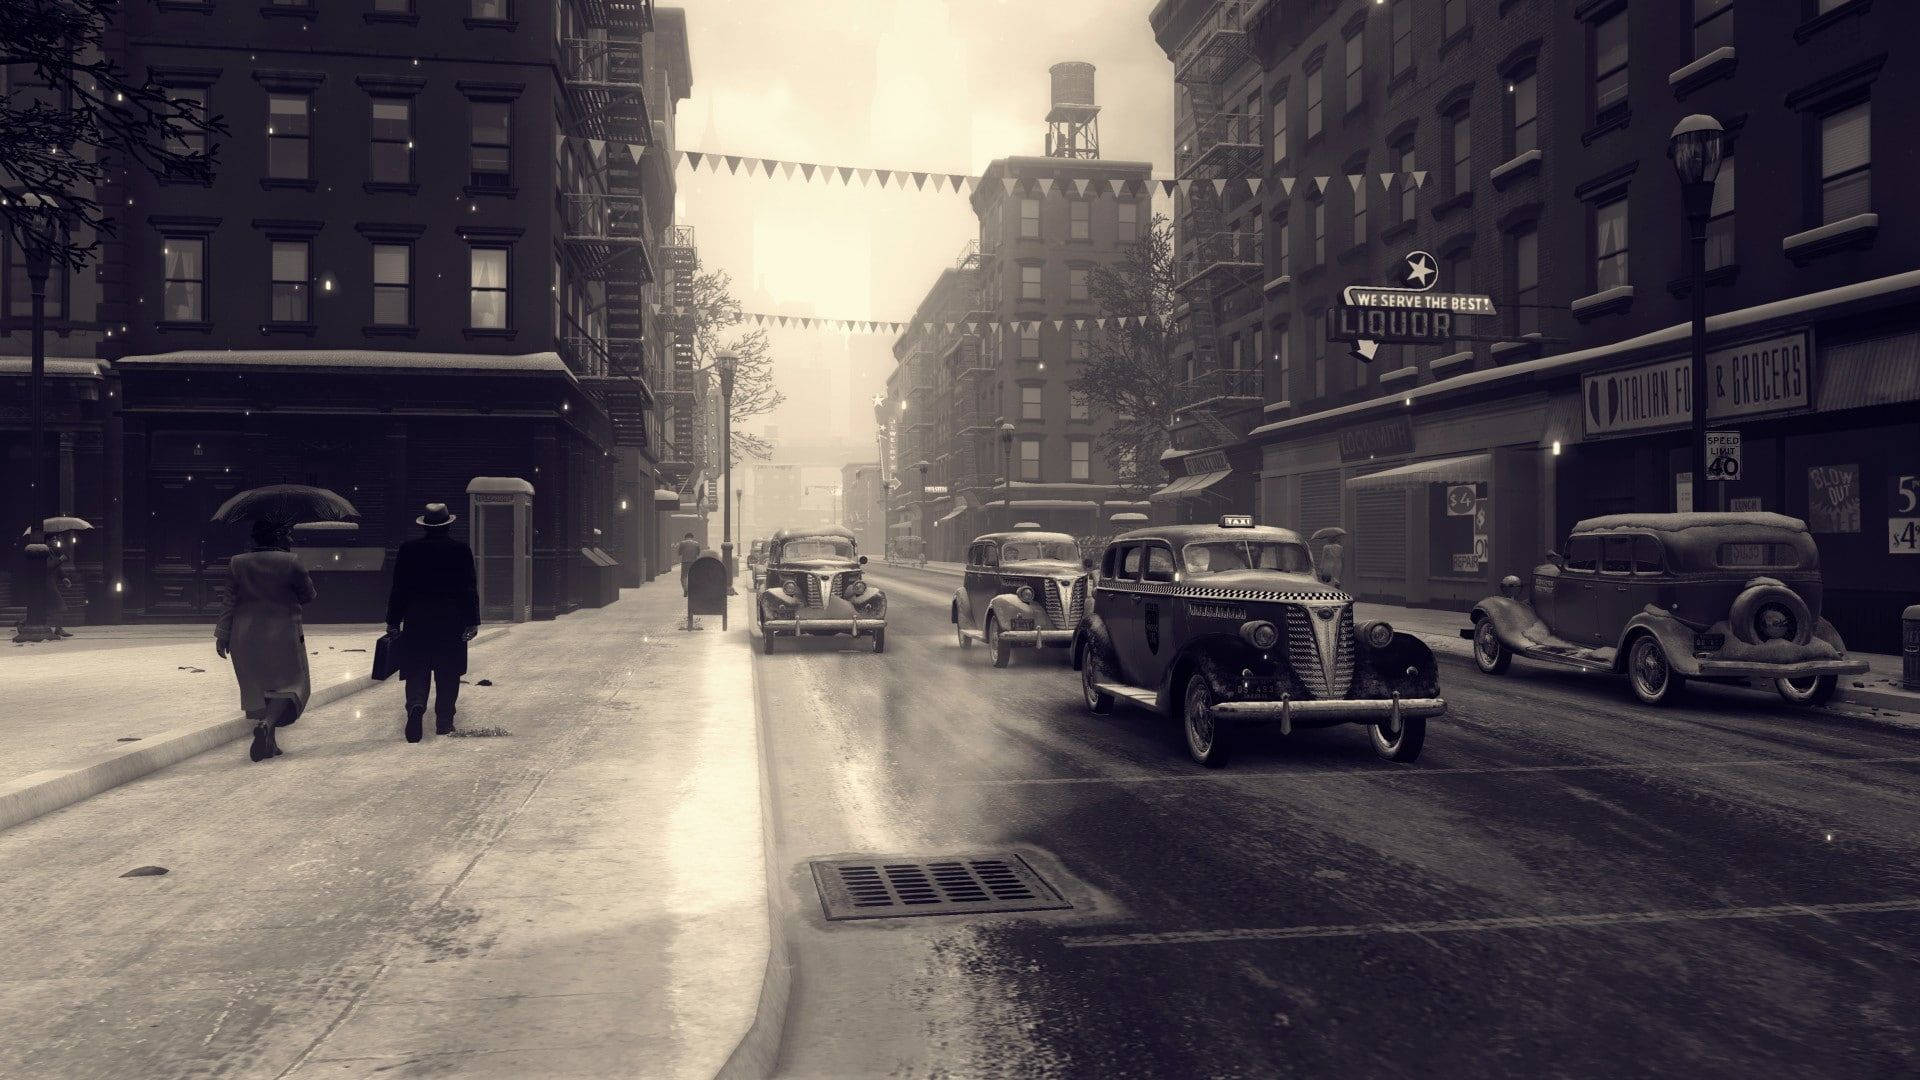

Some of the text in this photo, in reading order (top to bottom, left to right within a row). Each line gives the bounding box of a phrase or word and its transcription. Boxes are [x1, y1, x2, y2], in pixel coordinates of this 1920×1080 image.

[1357, 293, 1489, 311] WE SERVE THE BEST!
[1340, 309, 1450, 337] LIQUOR
[1619, 344, 1801, 422] ITALIAN FO & GROCERS
[1707, 436, 1739, 446] SPEED
[1710, 447, 1736, 456] LIMIT
[1708, 457, 1739, 476] 40
[1810, 467, 1853, 490] BLOW
[1449, 491, 1472, 507] $4
[1828, 485, 1852, 506] OUT
